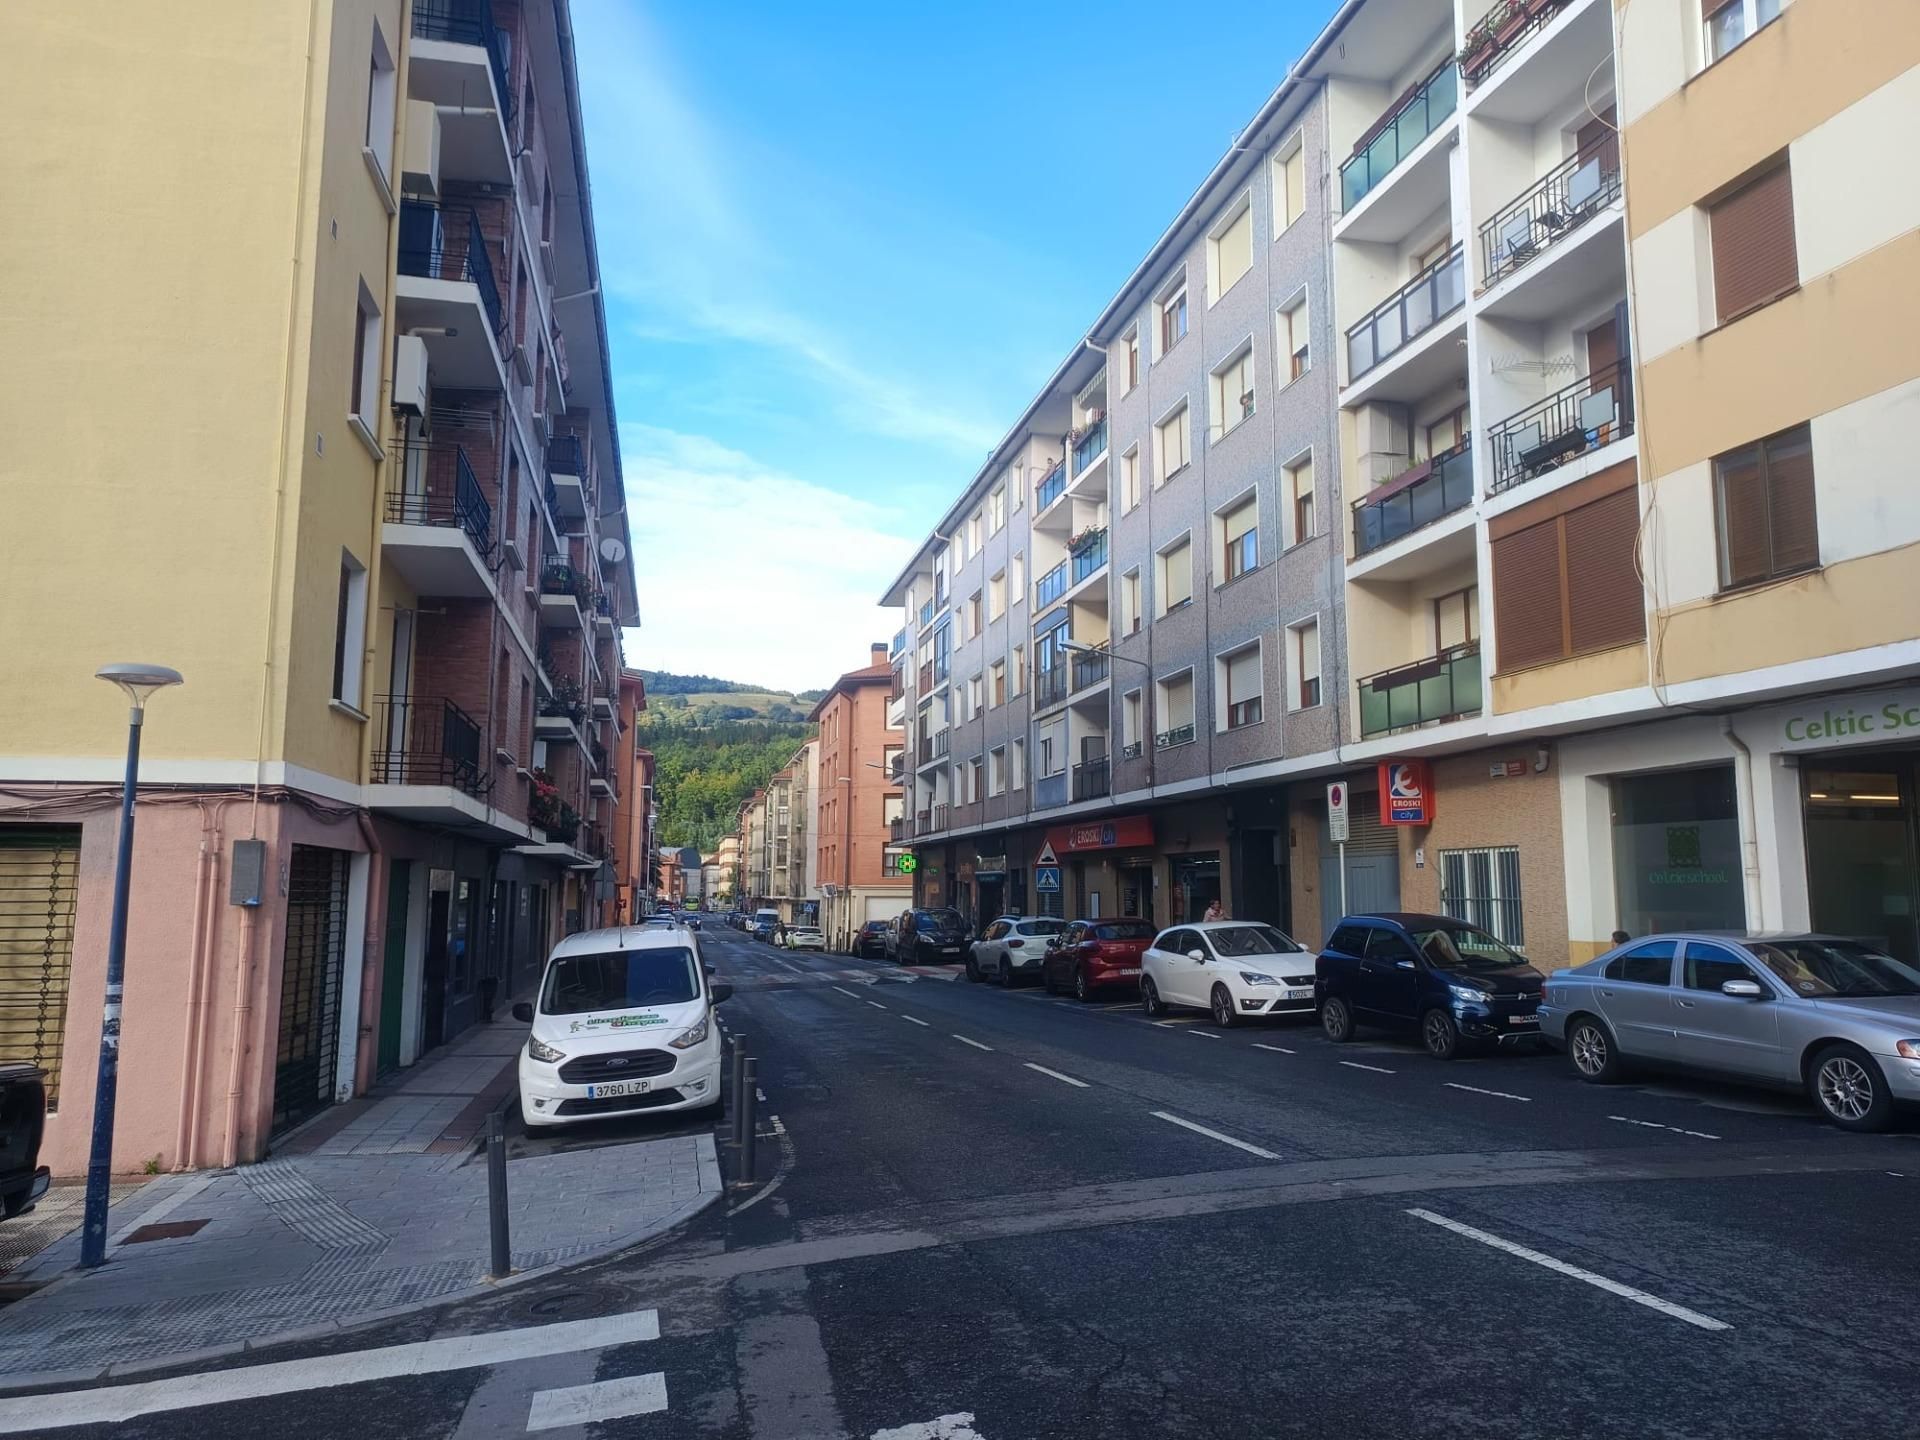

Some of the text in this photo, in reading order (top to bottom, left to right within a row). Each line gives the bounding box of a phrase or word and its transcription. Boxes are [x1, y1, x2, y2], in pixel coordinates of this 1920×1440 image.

[1785, 709, 1874, 741] Celtic
[1400, 811, 1414, 820] city
[1077, 829, 1100, 843] EROSKI
[596, 1081, 648, 1097] 3760 LZP
